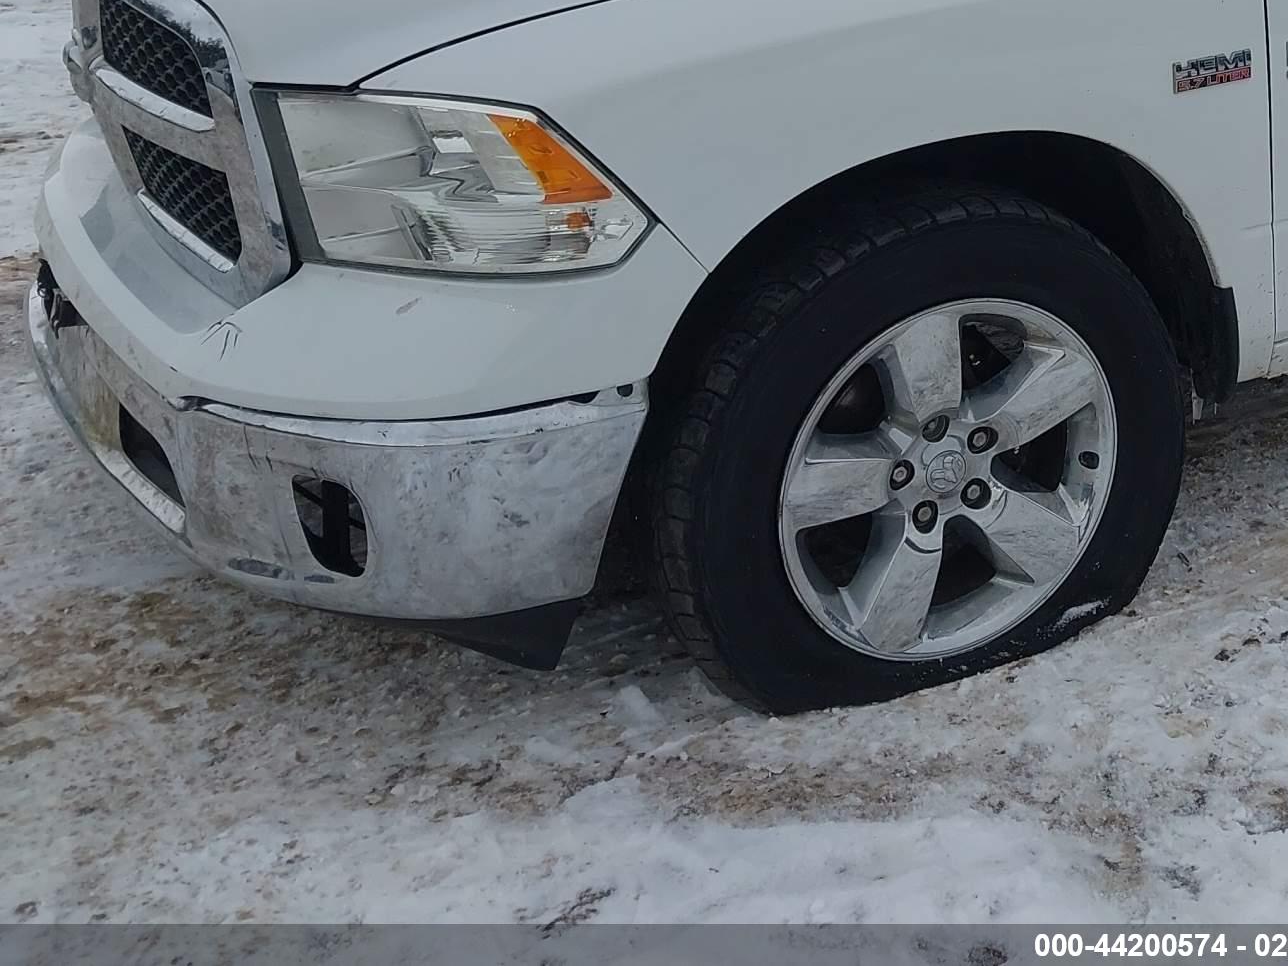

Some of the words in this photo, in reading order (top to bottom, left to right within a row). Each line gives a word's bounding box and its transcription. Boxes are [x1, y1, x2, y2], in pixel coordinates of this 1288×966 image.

[1172, 49, 1252, 78] HEMI
[1176, 76, 1206, 93] 5.7
[1206, 66, 1251, 85] LITER
